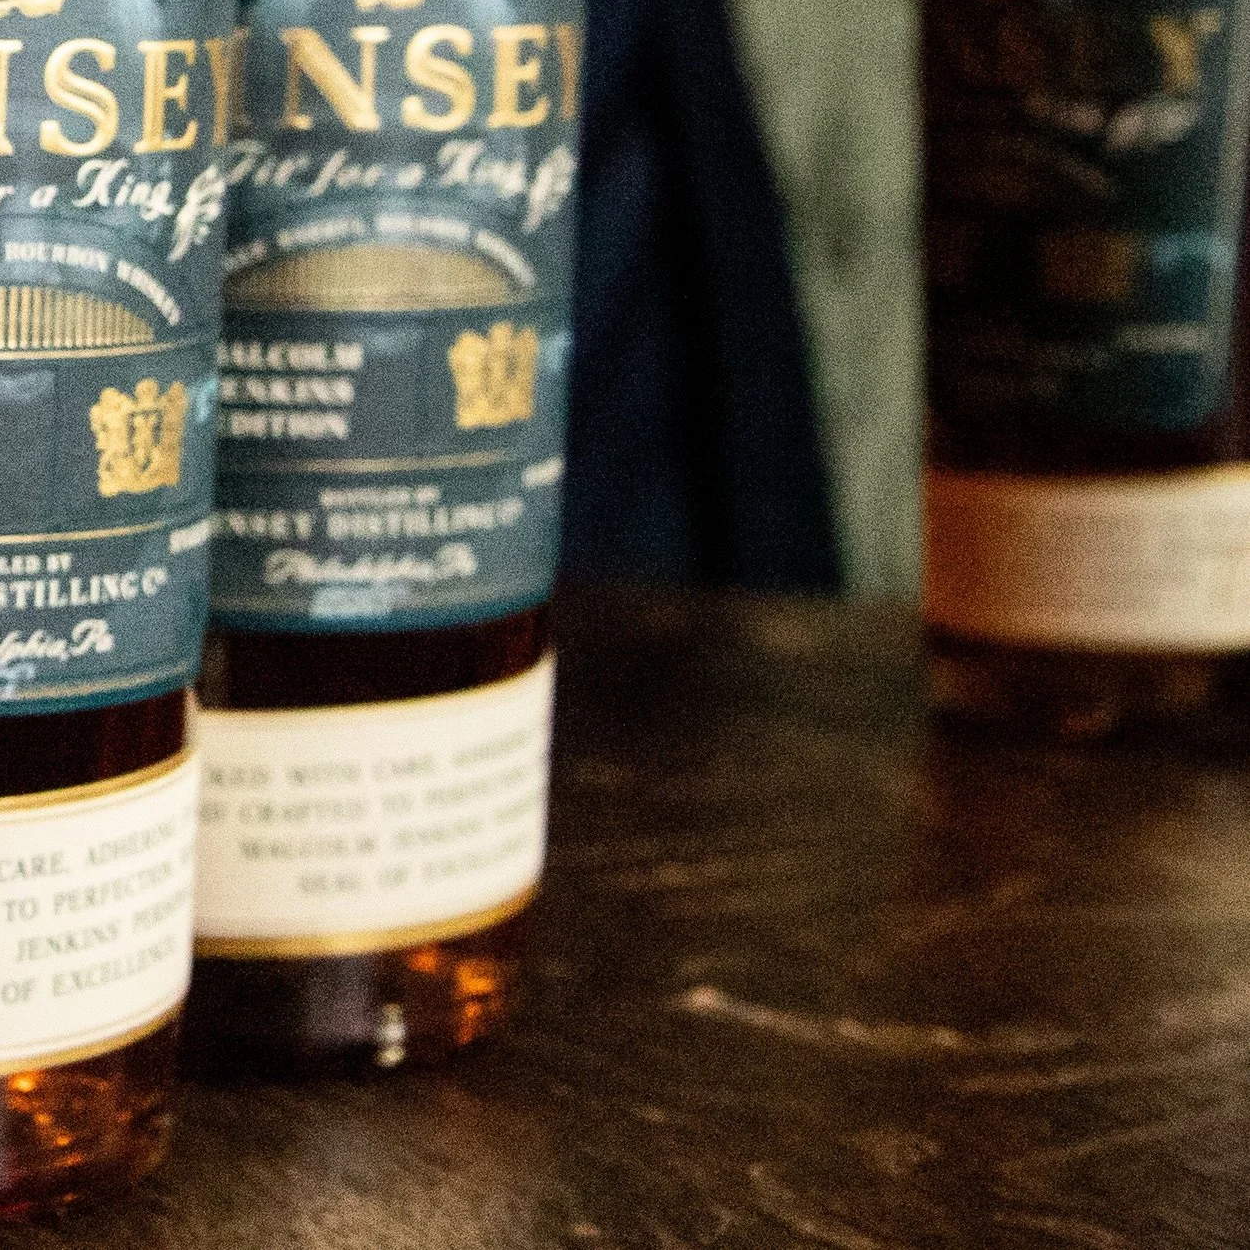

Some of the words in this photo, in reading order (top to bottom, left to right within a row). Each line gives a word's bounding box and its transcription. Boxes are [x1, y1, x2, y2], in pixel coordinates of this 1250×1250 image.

[31, 185, 56, 208] a
[72, 158, 173, 220] King
[3, 896, 40, 923] TO
